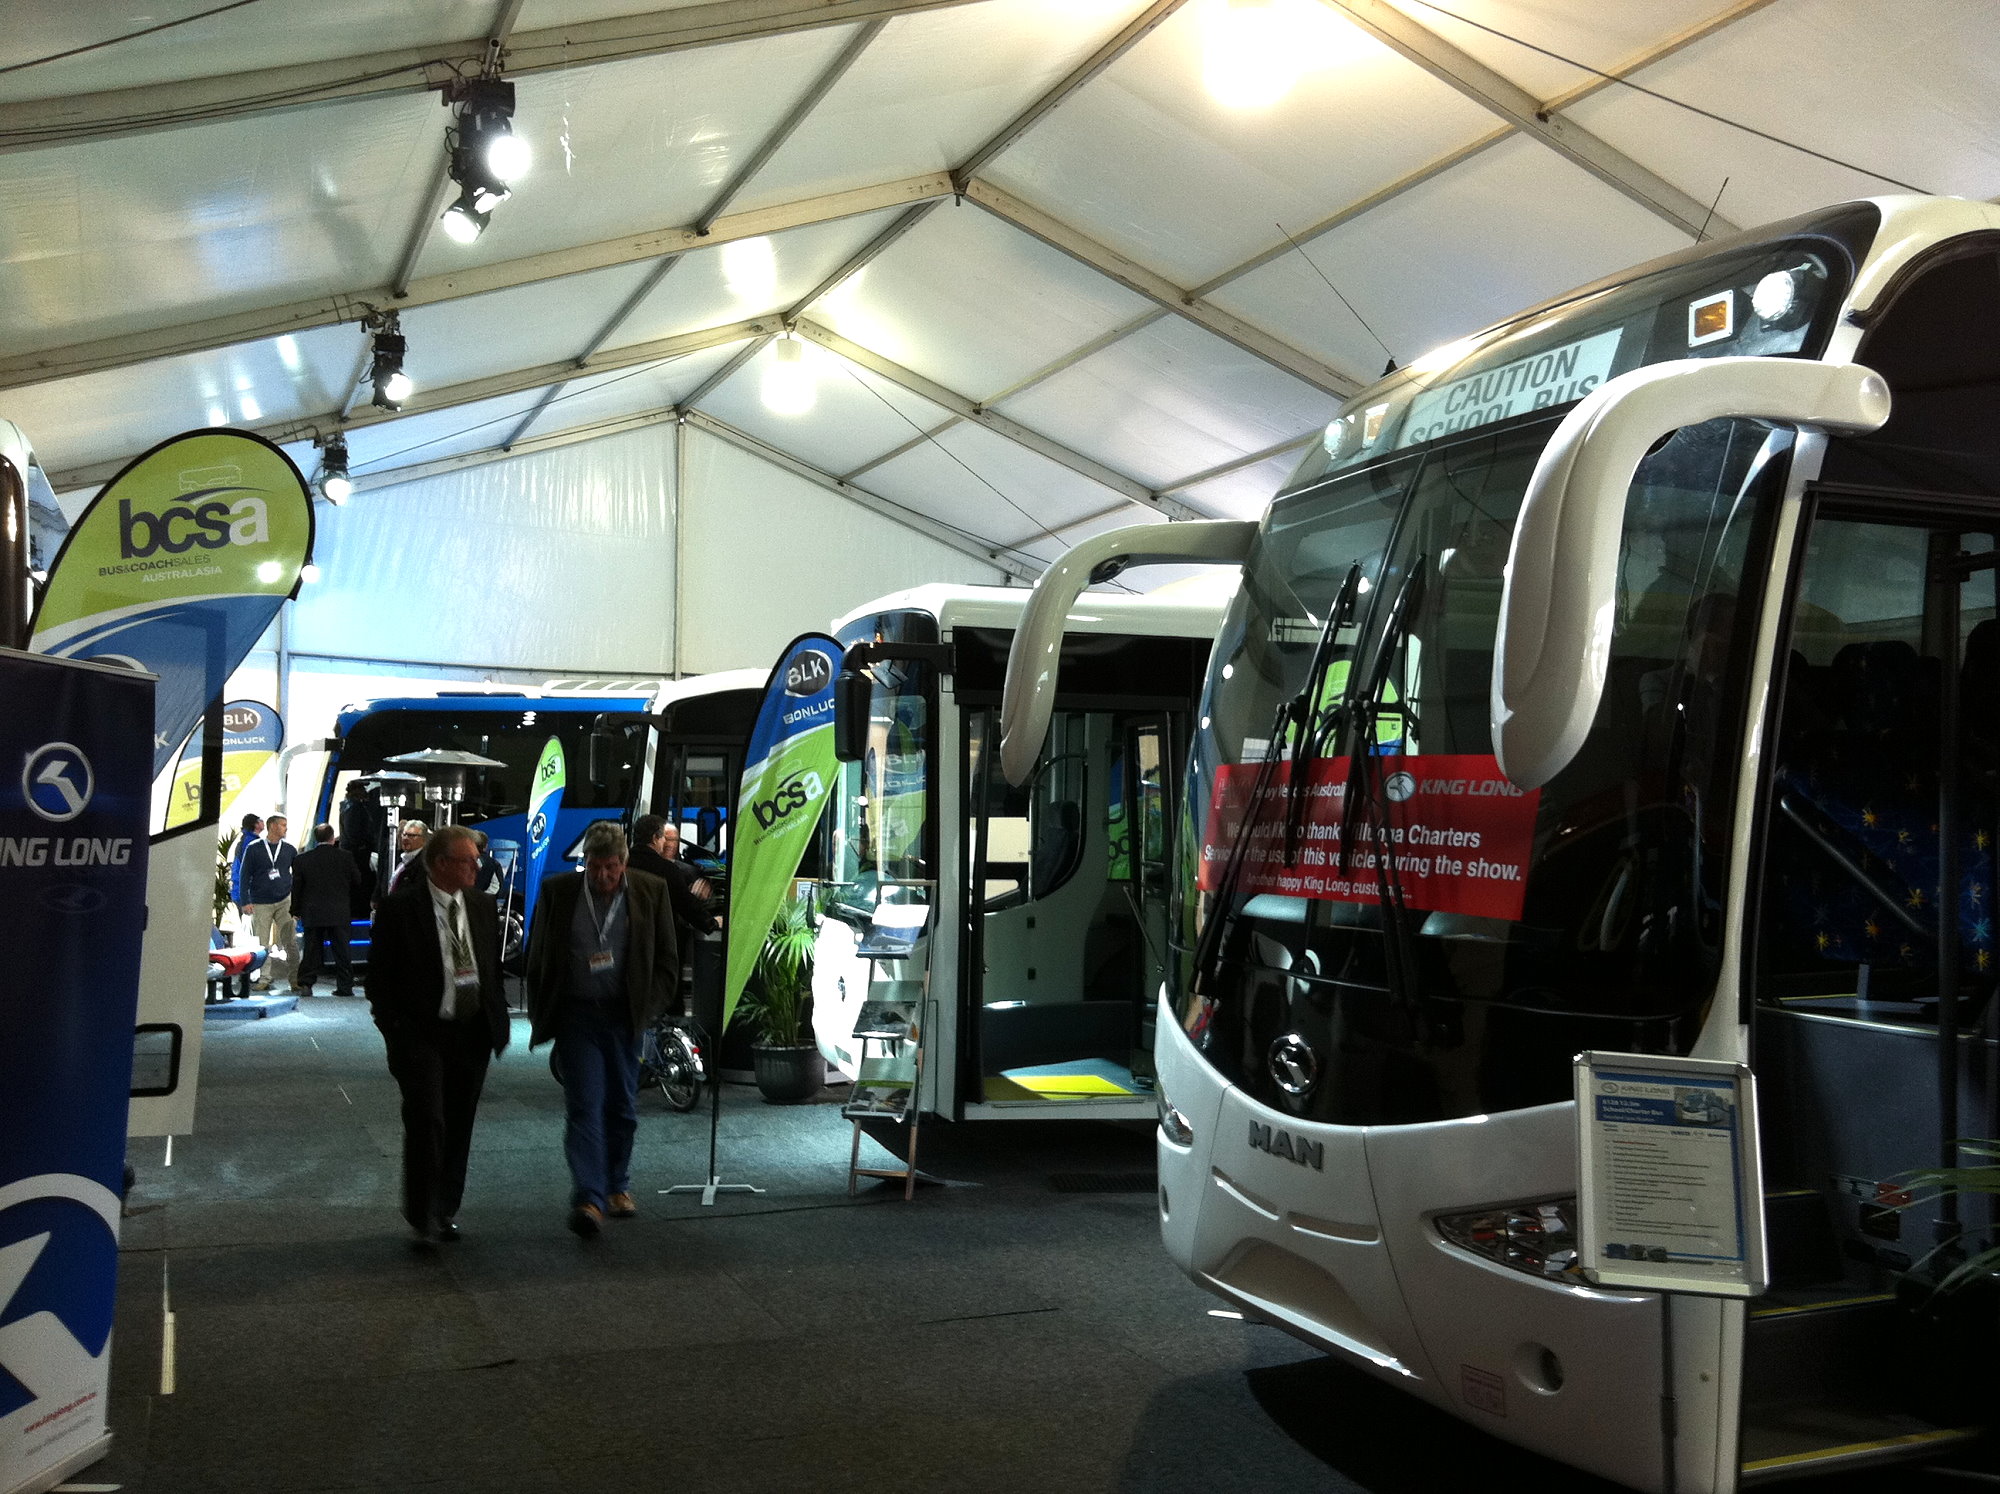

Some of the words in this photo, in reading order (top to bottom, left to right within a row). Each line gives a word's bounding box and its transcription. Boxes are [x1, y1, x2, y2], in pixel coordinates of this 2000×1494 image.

[1443, 343, 1584, 415] CAUTION
[1408, 401, 1517, 446] SCHOOL
[1532, 374, 1600, 410] BUS
[117, 496, 271, 560] bcsa
[141, 565, 223, 583] AUSTRALASIA
[786, 656, 827, 689] BLK
[223, 713, 255, 726] BLK
[782, 698, 836, 725] BONLUC
[222, 736, 267, 746] ONLUCK
[752, 770, 825, 831] bcsa
[1310, 780, 1354, 798] Australi
[1418, 779, 1467, 796] KING
[1306, 821, 1341, 840] thank
[1407, 824, 1481, 849] Charters
[0, 836, 49, 867] ING
[54, 836, 133, 867] LONG
[1303, 846, 1327, 867] this
[1435, 854, 1462, 876] the
[1466, 857, 1522, 882] show.
[1276, 873, 1303, 893] happy
[1303, 875, 1325, 892] King
[1325, 876, 1350, 896] Long
[1247, 1118, 1325, 1171] MAN
